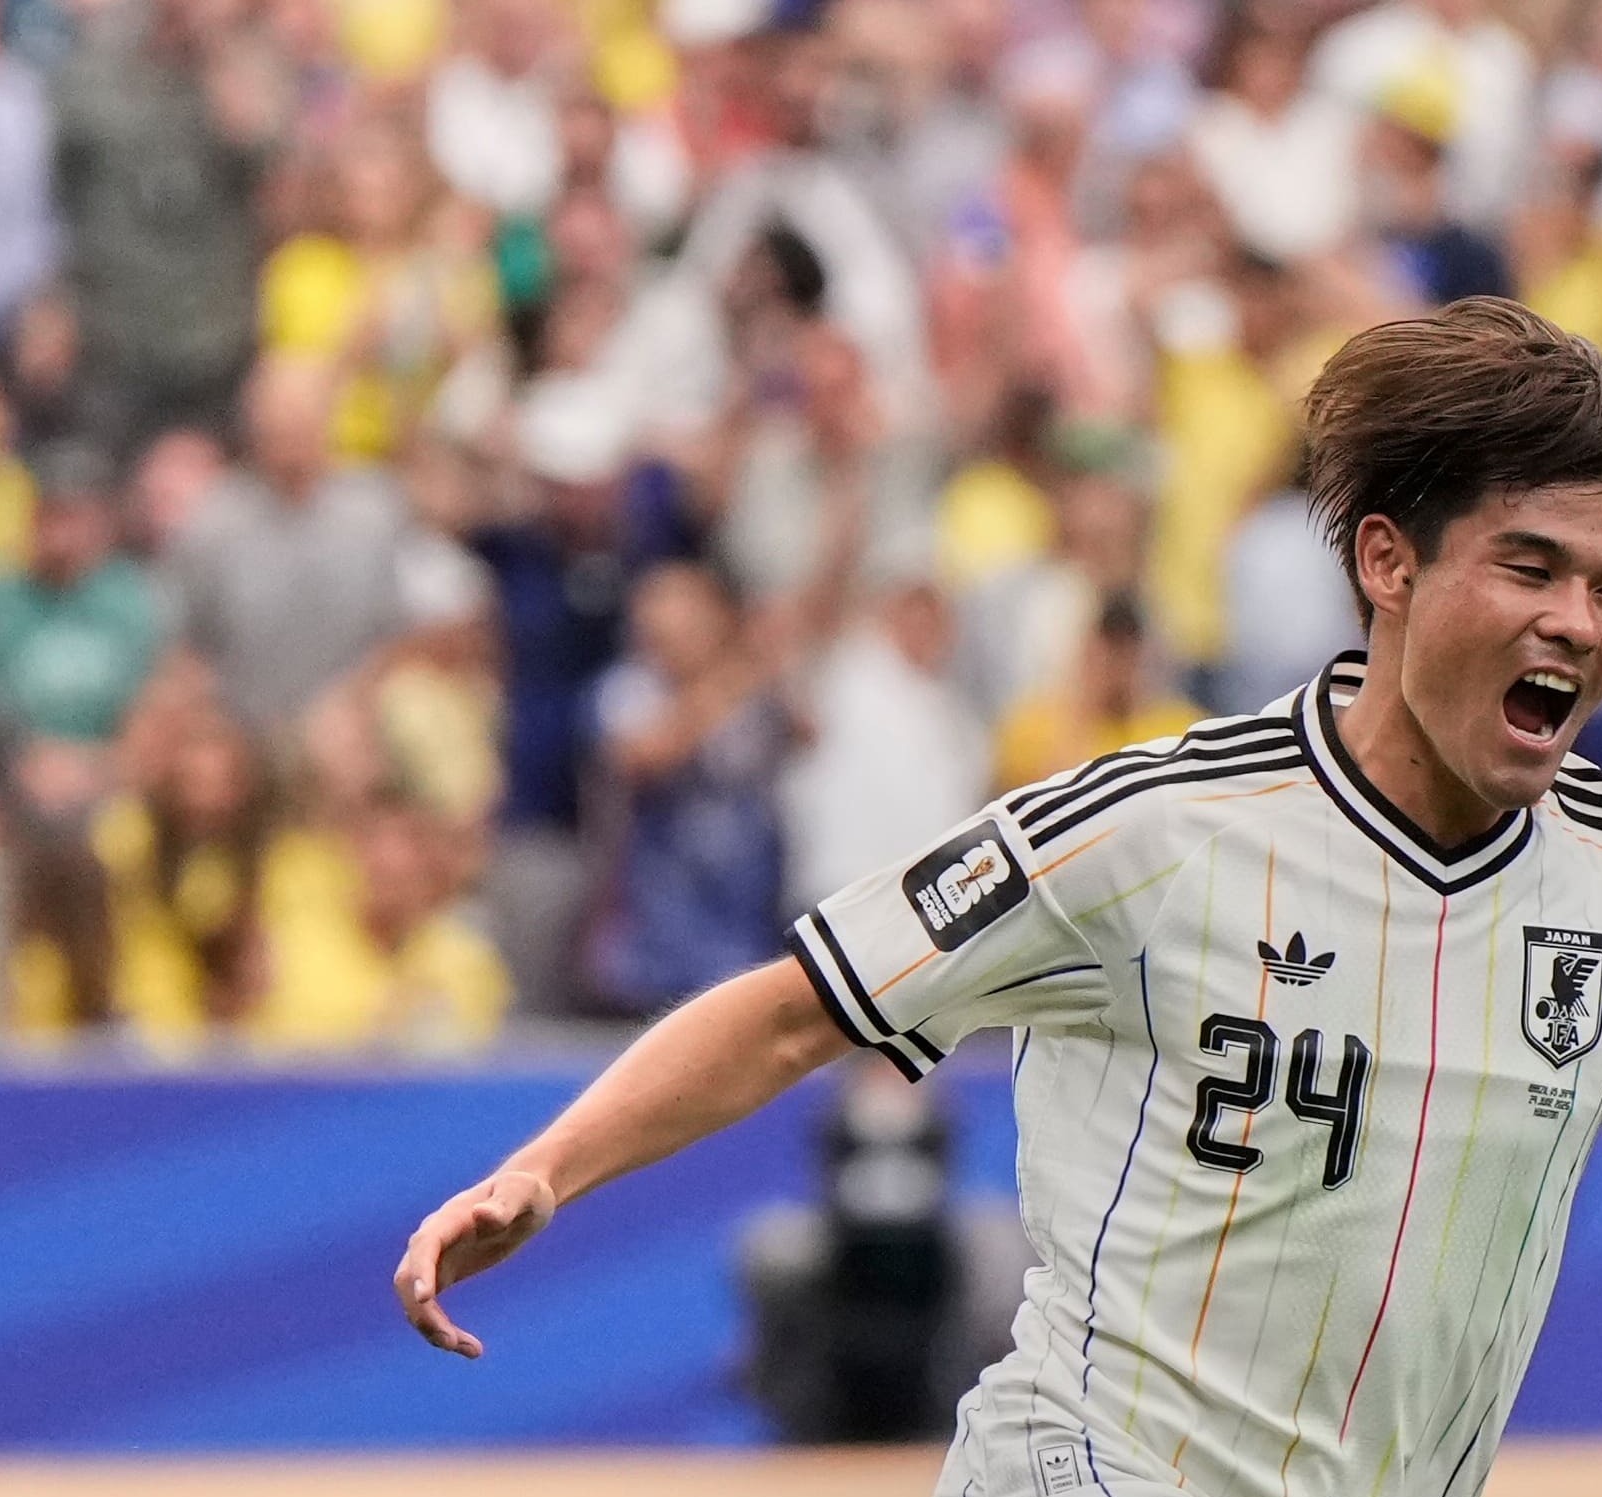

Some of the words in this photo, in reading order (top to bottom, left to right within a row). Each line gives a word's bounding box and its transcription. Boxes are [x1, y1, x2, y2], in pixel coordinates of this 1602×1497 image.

[946, 884, 961, 904] FIFA
[915, 889, 947, 931] 2026
[1545, 930, 1591, 946] JAPAN
[1543, 1021, 1579, 1047] JFA
[1186, 1012, 1373, 1191] 24
